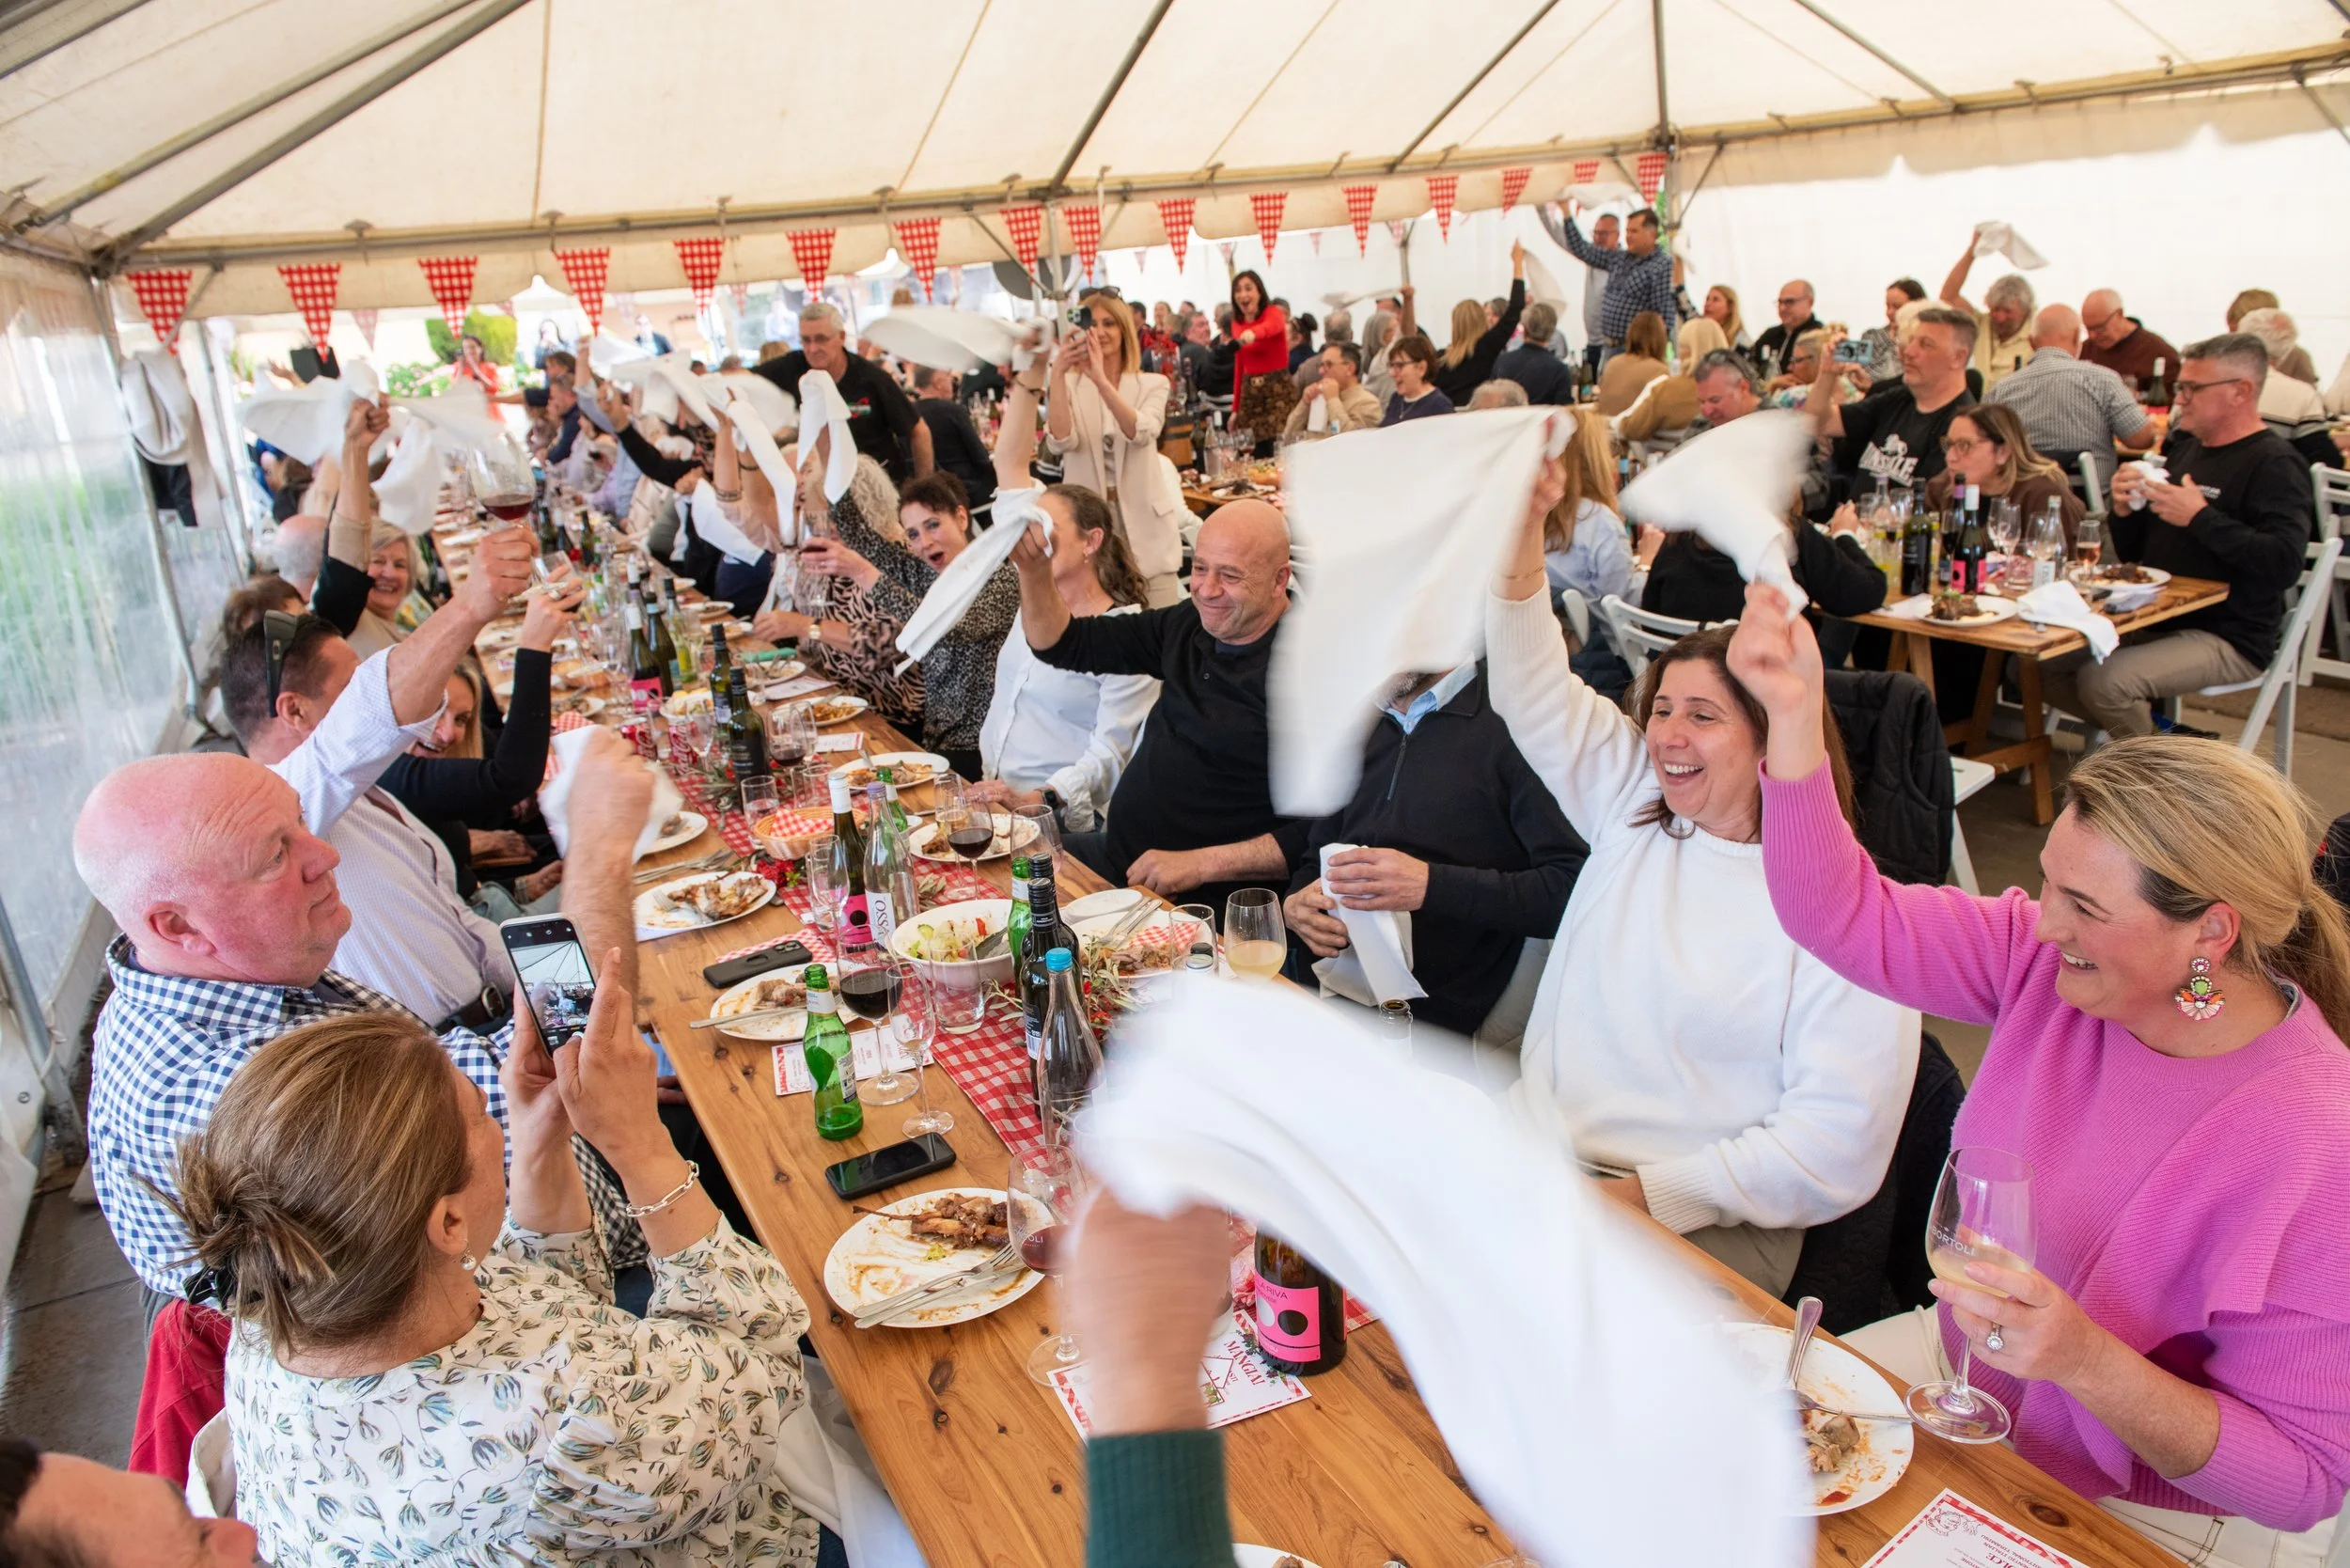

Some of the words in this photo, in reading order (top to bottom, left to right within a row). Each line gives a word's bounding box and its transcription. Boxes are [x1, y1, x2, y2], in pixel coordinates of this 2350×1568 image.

[1266, 1286, 1289, 1300] RIVA
[1224, 1340, 1265, 1385] MANGIA!
[1981, 1534, 2011, 1552] TIRAMISU
